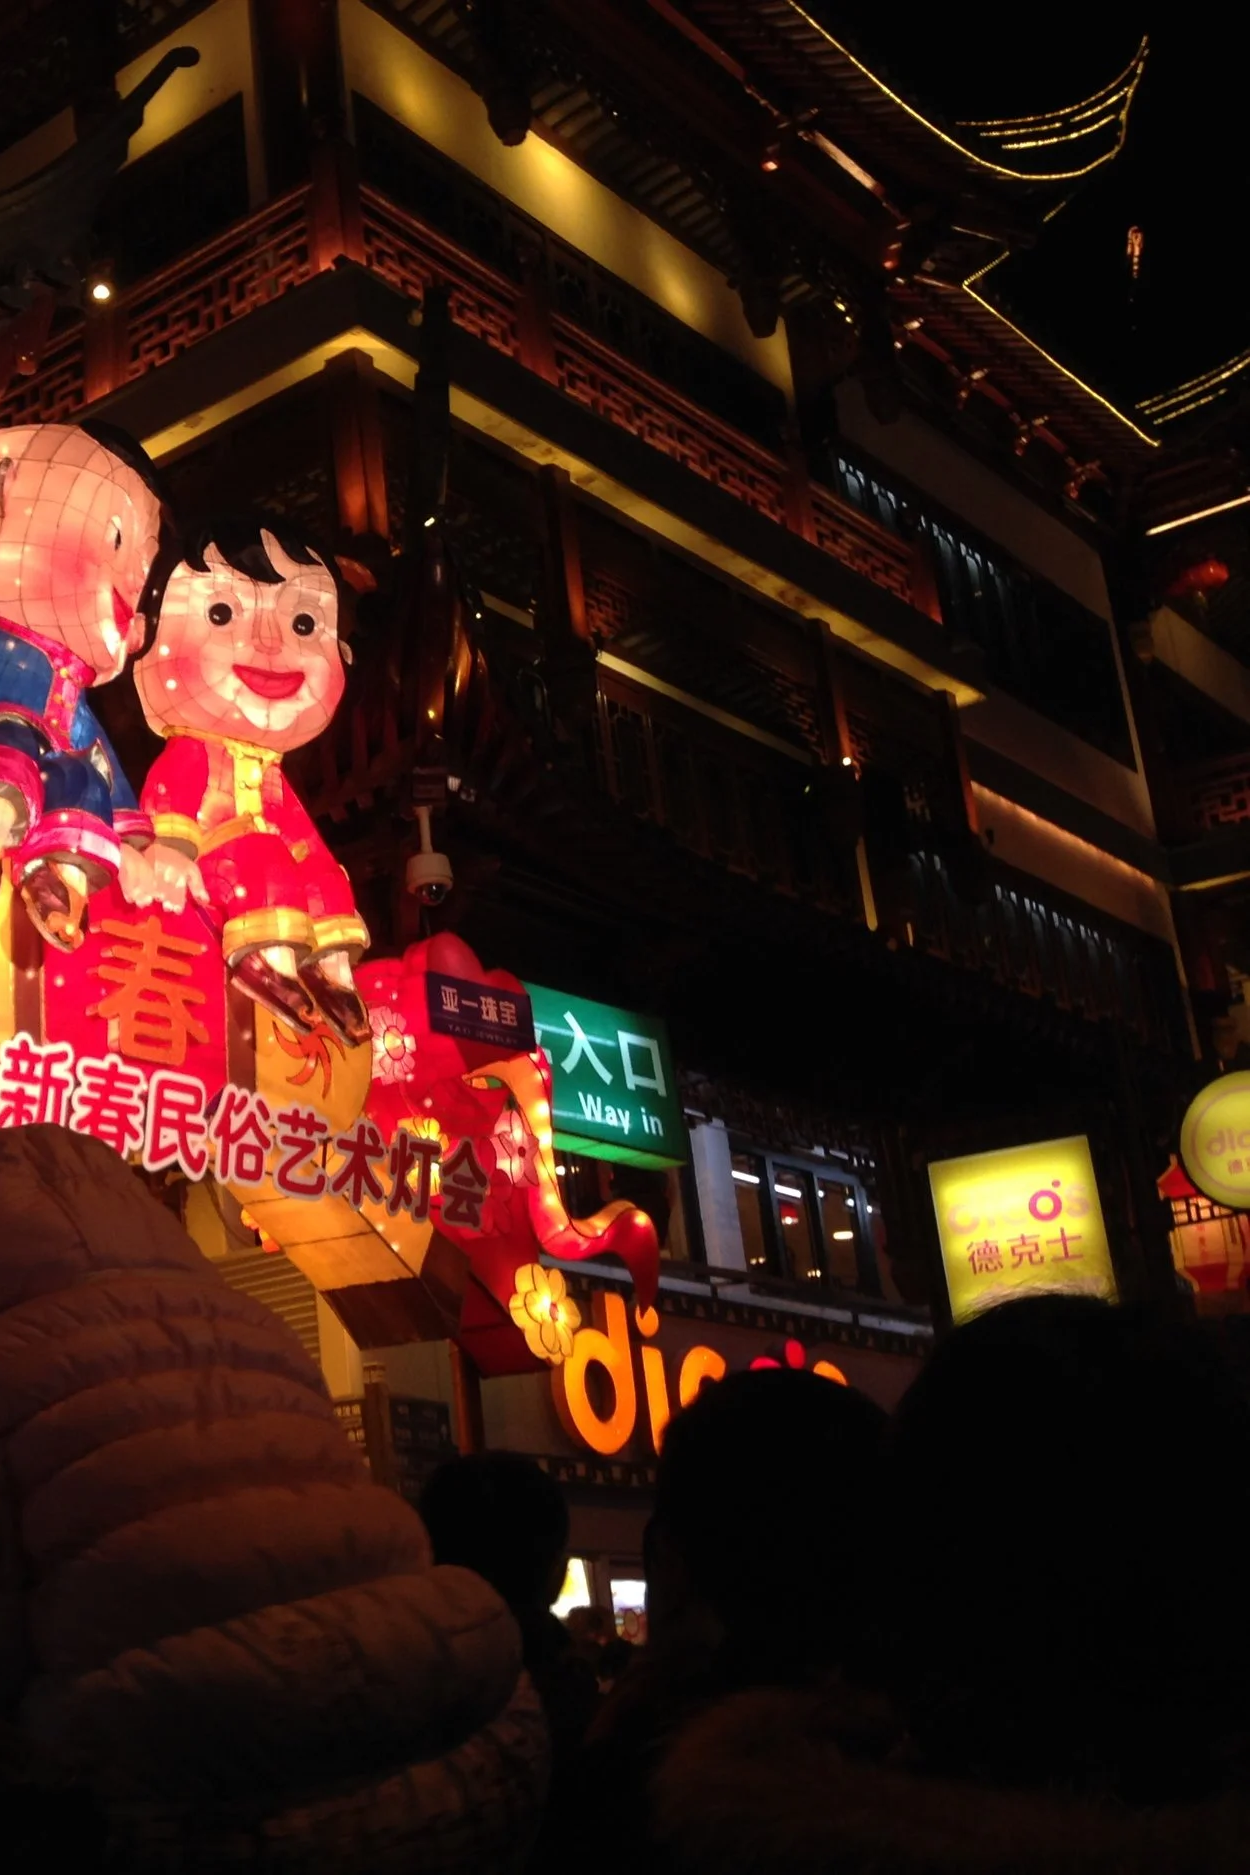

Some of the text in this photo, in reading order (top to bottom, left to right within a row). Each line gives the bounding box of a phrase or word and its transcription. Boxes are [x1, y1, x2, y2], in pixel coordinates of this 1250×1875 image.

[90, 916, 210, 1067] 春
[440, 985, 518, 1027] 亚一珠宝
[560, 1010, 667, 1097] 入口
[578, 1090, 664, 1137] Way in
[966, 1226, 1084, 1277] 德克士
